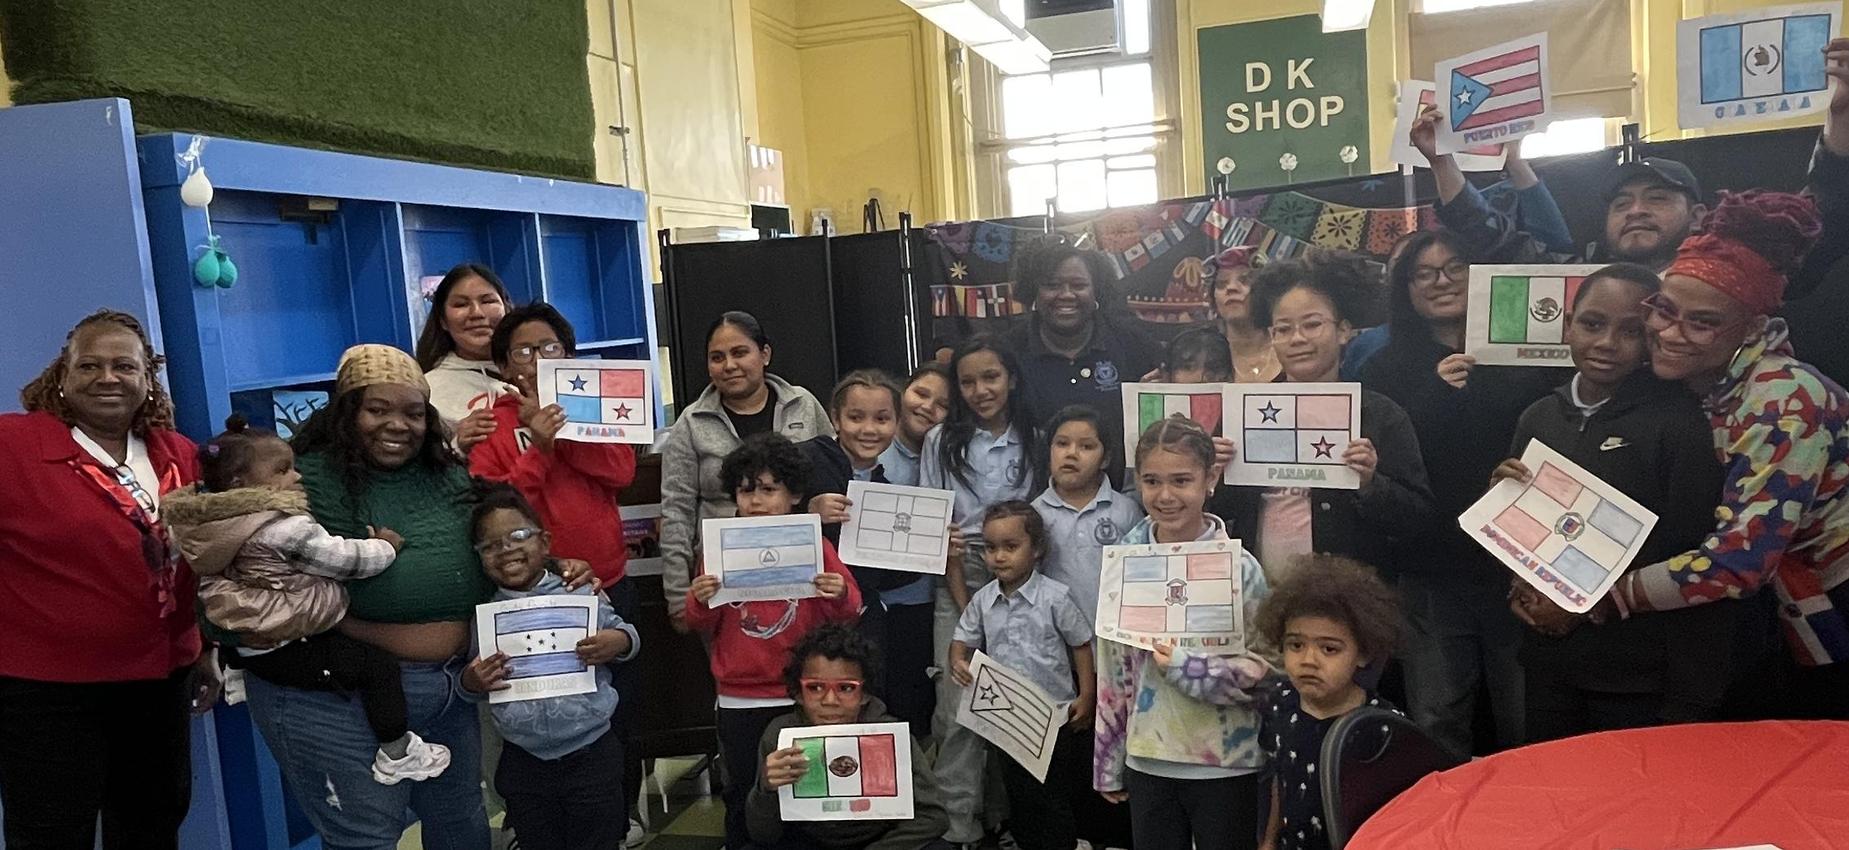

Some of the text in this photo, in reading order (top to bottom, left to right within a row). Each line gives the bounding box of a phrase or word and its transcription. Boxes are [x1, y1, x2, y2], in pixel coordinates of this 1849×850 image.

[1245, 57, 1315, 93] D K
[1225, 95, 1345, 134] SHOP
[1463, 124, 1508, 145] PUERTO
[1517, 347, 1570, 360] MEXICO
[576, 425, 626, 438] PANAMA
[1267, 466, 1327, 481] PANAMA
